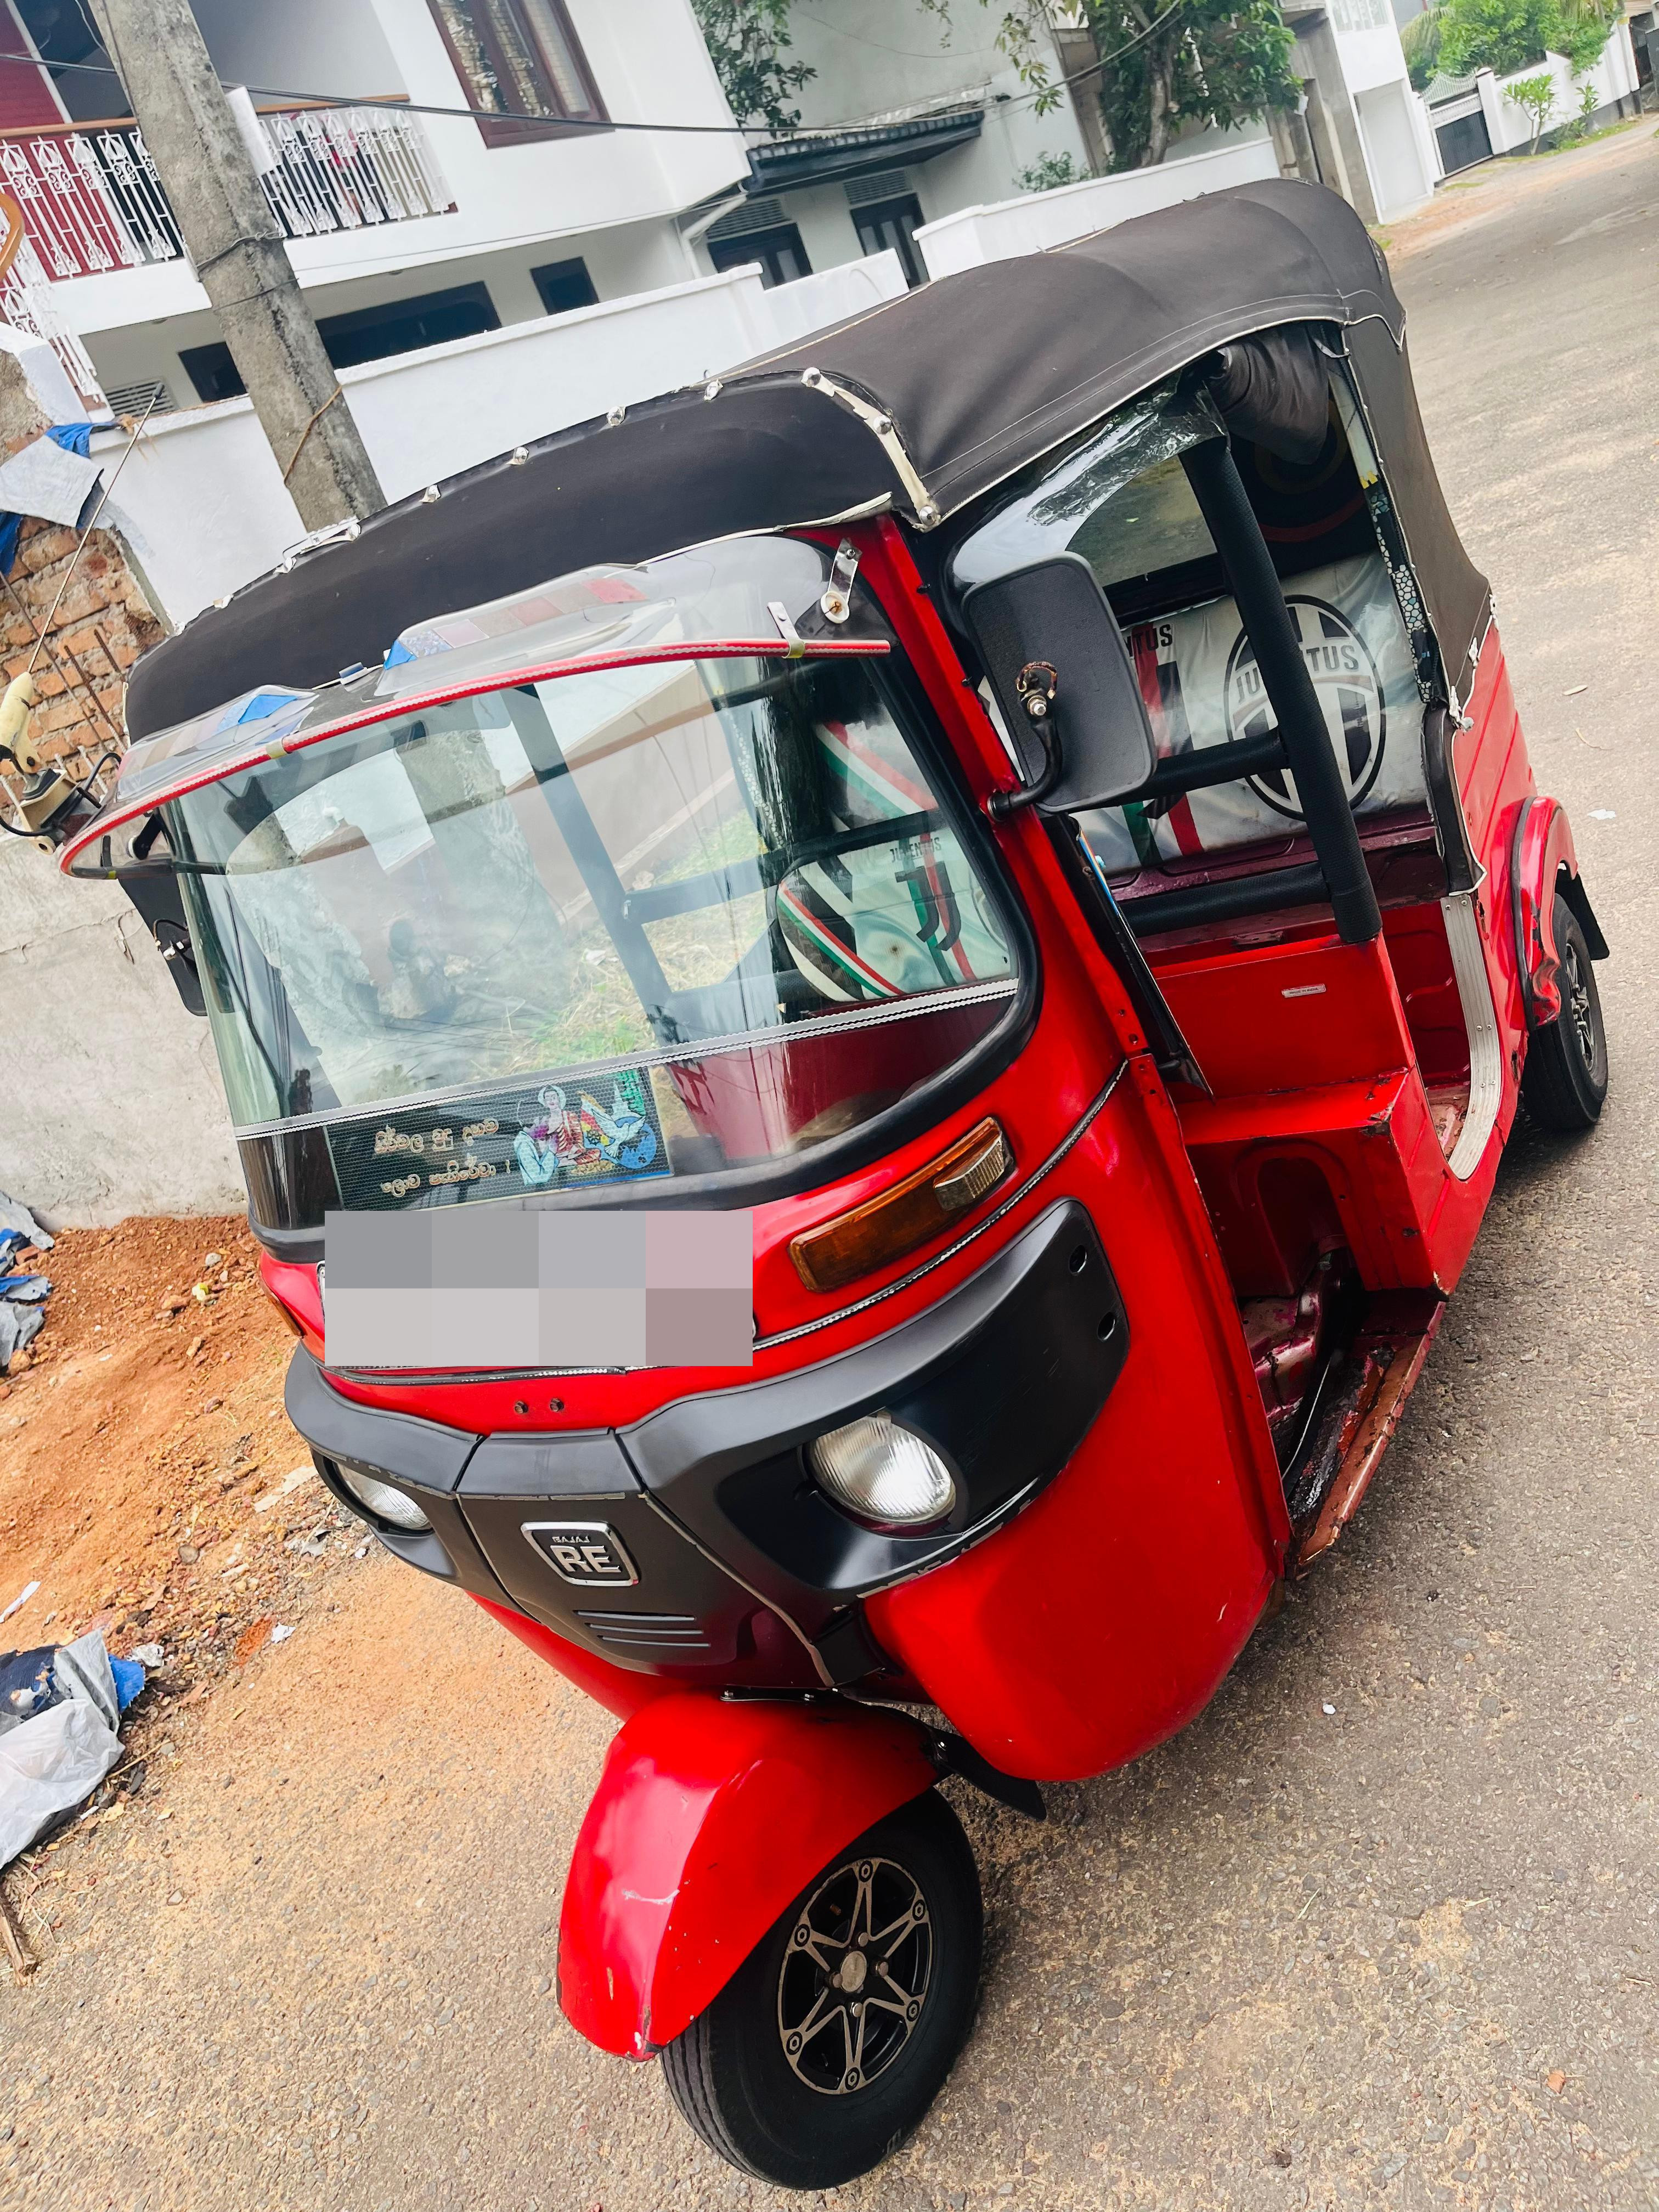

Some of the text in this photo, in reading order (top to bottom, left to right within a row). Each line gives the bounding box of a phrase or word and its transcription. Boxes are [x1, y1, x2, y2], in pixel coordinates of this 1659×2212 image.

[1123, 624, 1173, 657] NTUS
[1236, 645, 1359, 703] JUTUS
[551, 1535, 590, 1543] BAJAJ
[550, 1544, 622, 1573] RE
